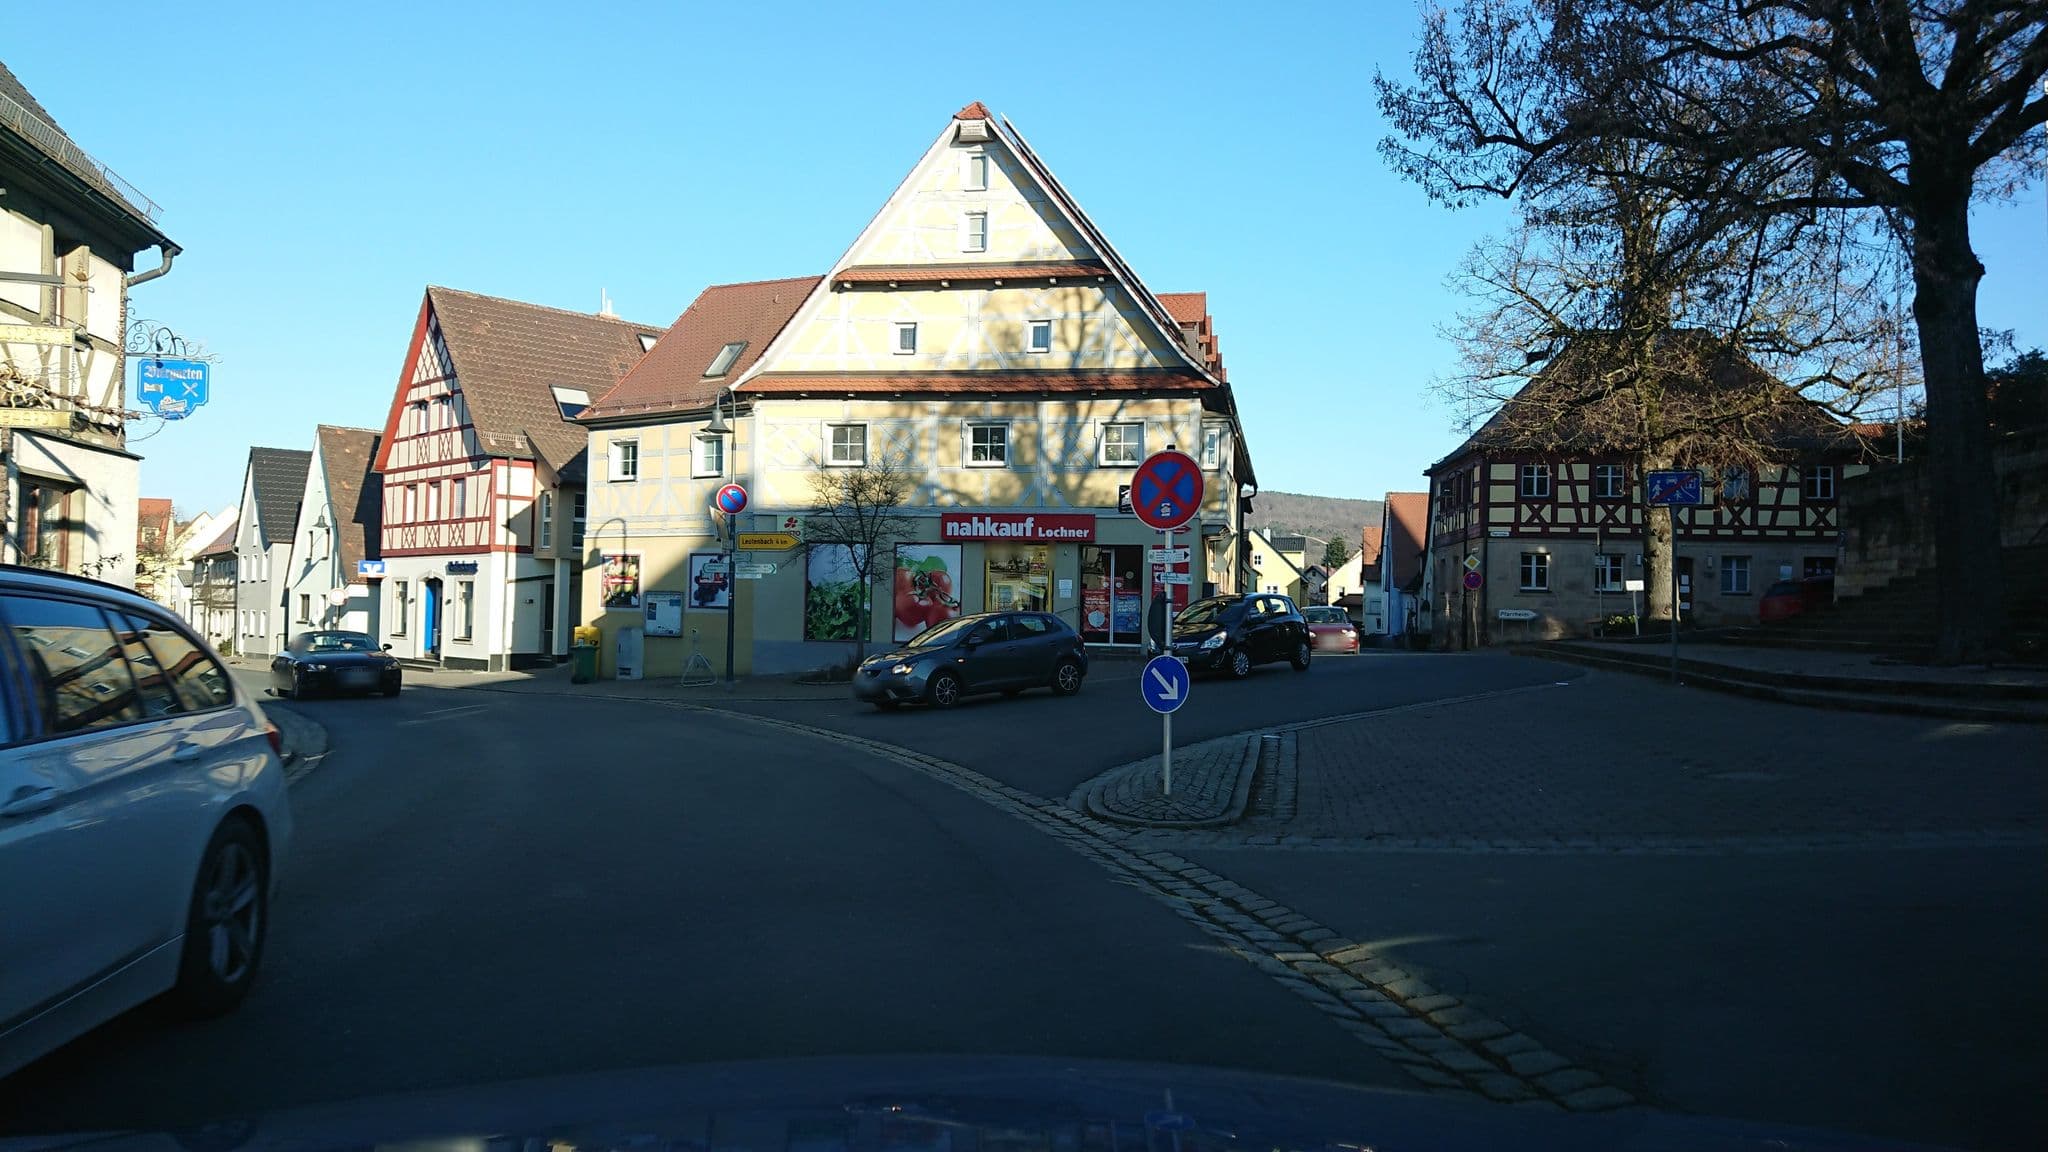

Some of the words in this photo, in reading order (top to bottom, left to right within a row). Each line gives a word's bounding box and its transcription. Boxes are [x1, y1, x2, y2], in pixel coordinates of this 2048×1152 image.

[143, 365, 203, 381] Biergarten
[946, 516, 1034, 537] nahkauf
[1038, 526, 1090, 538] Lochner
